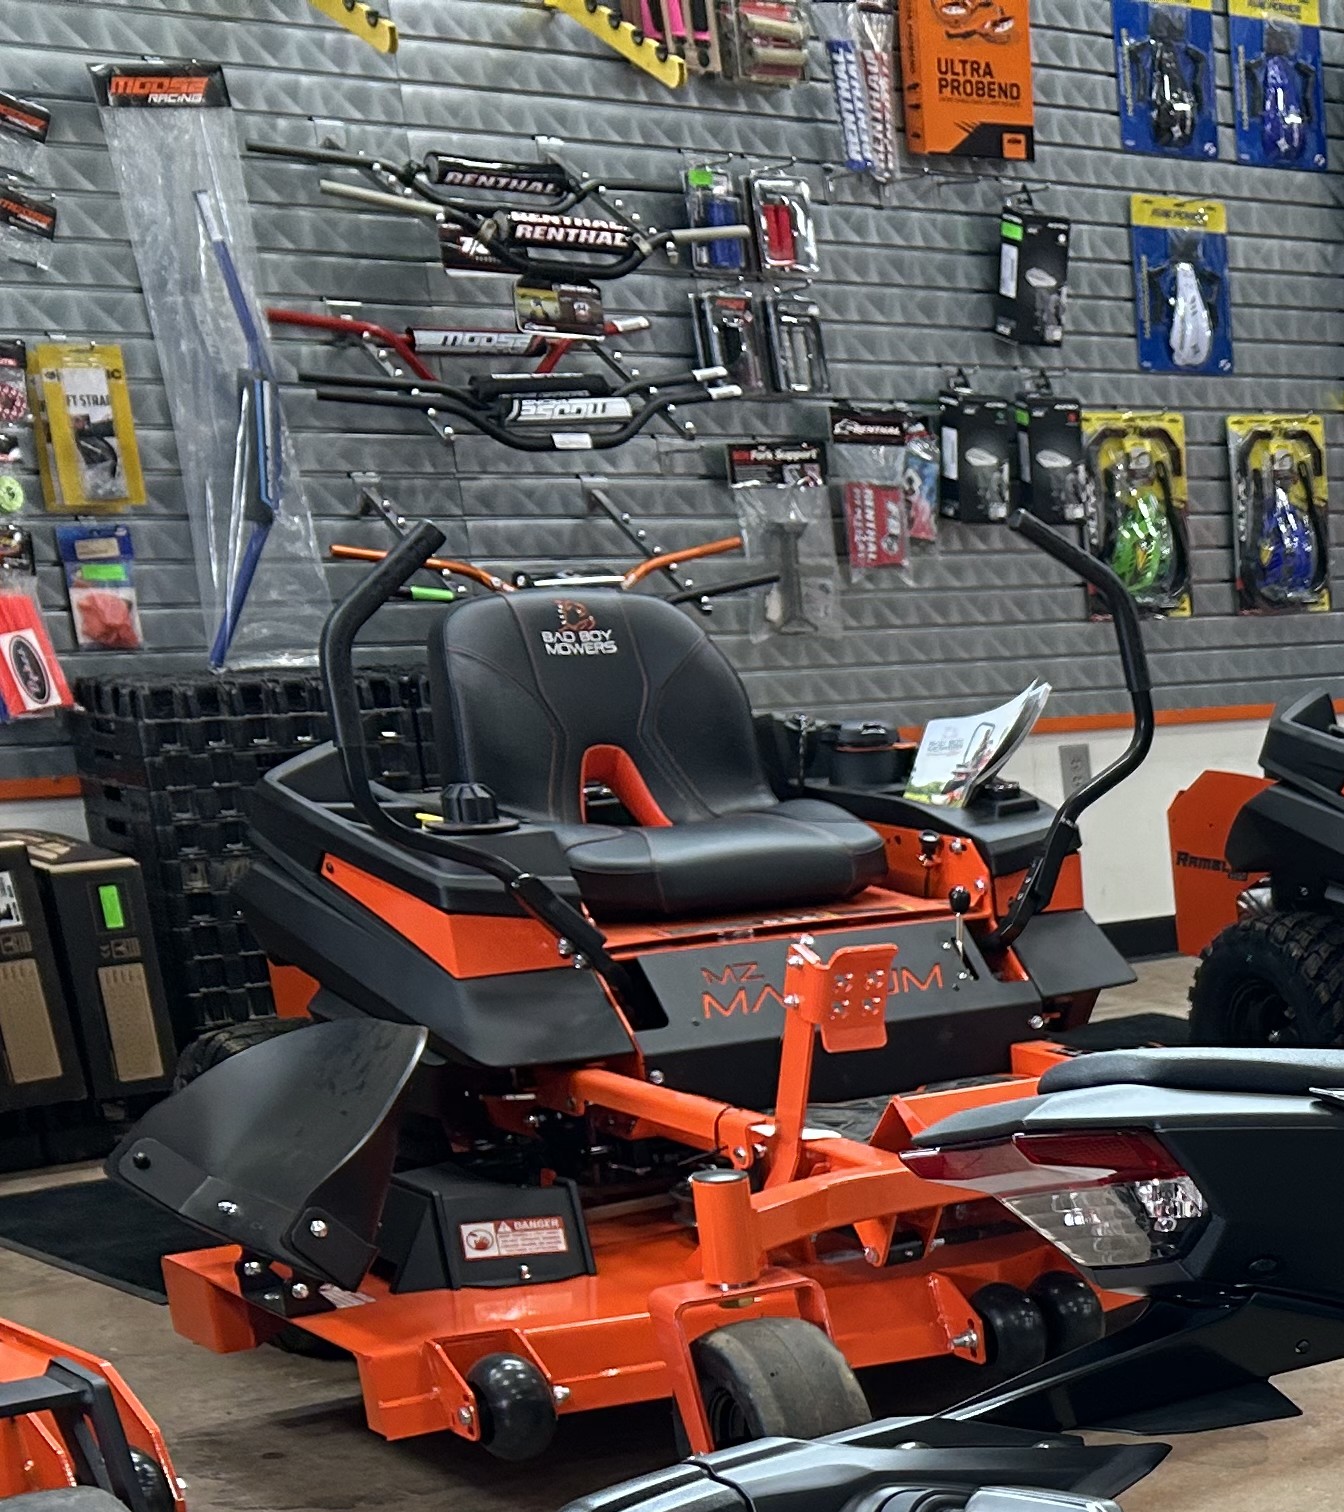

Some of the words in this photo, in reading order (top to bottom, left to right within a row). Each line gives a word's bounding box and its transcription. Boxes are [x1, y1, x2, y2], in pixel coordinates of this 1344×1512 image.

[936, 56, 995, 79] ULTRA
[110, 76, 209, 95] MOOSE
[937, 77, 1022, 101] PROBEND
[147, 93, 204, 104] RACING
[443, 170, 562, 194] RENTHAL
[514, 223, 631, 248] RENTHAL
[541, 630, 576, 644] BAD
[578, 628, 613, 643] BOY
[544, 640, 619, 656] MOWERS
[700, 960, 766, 987] MZ
[513, 1218, 560, 1231] DANGER
